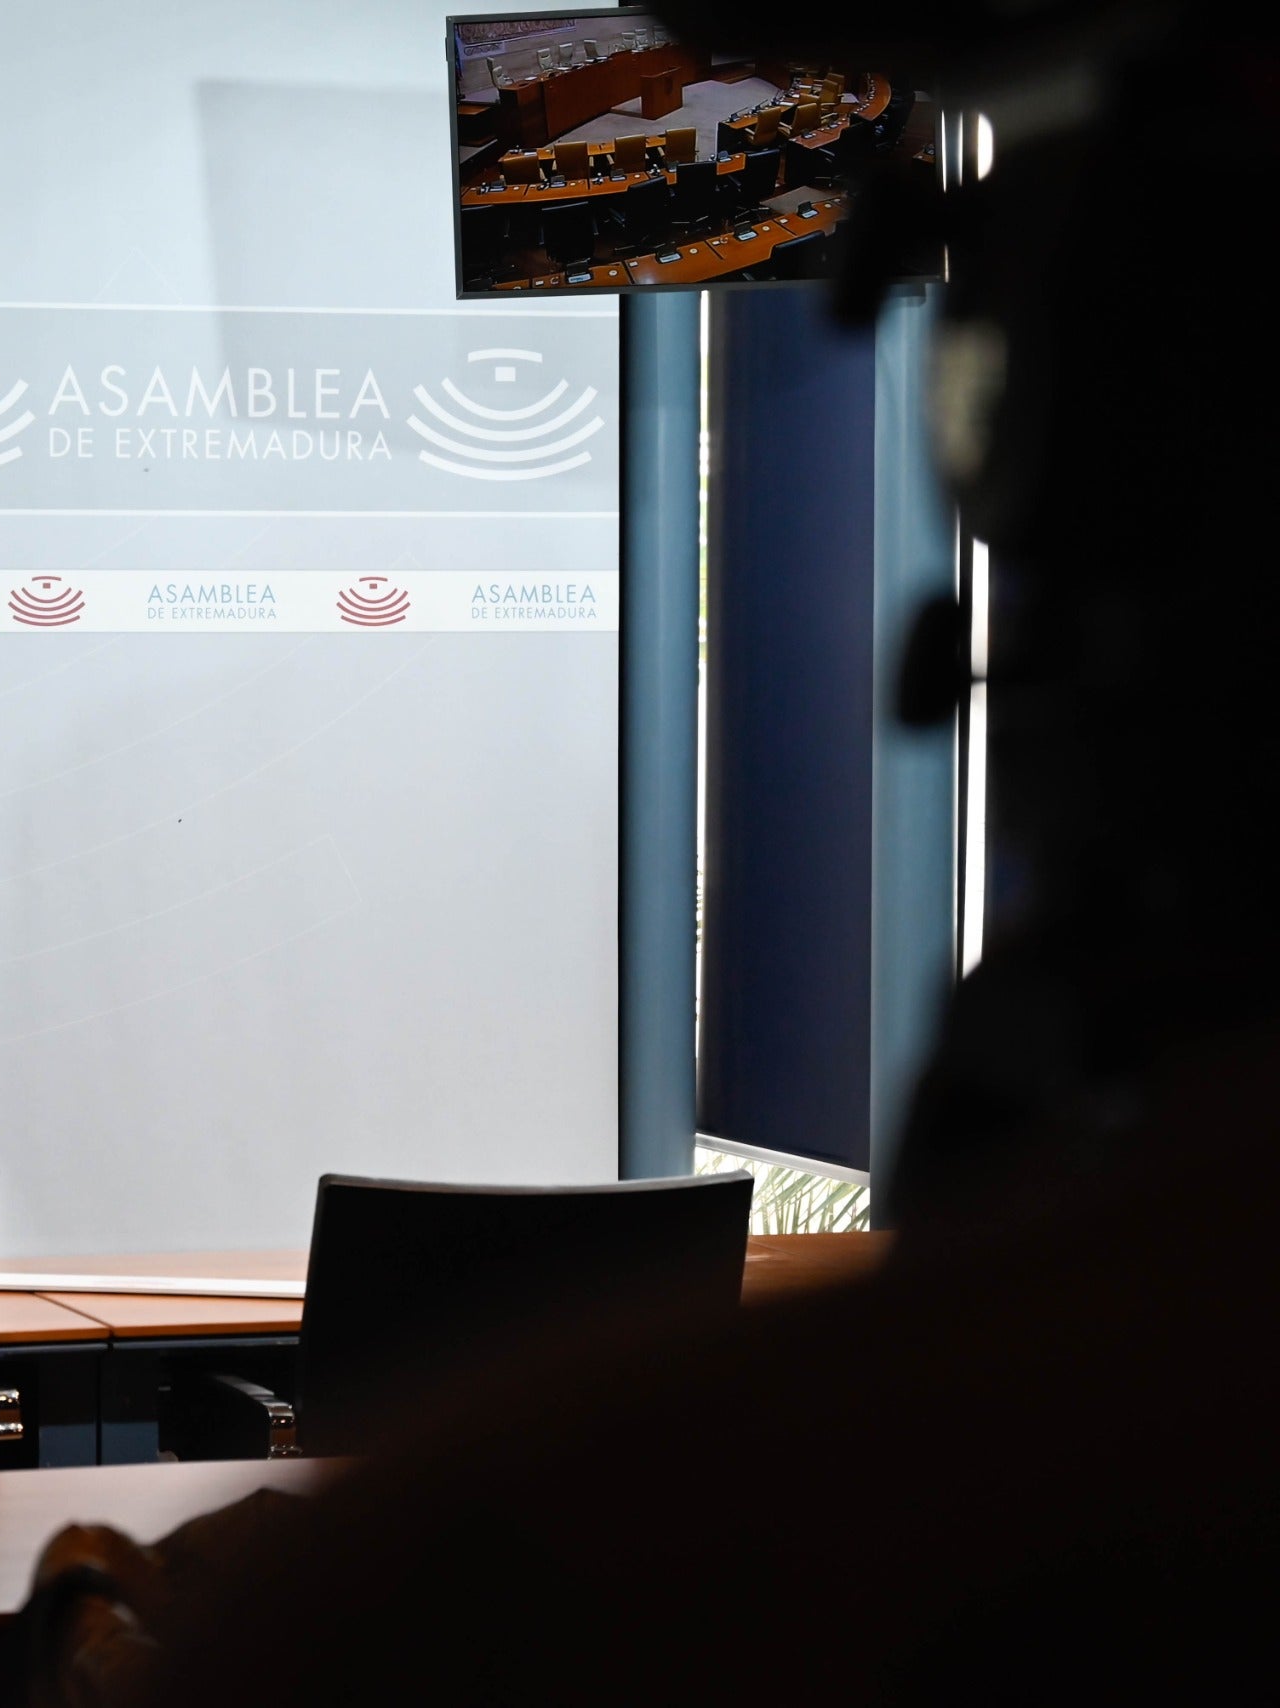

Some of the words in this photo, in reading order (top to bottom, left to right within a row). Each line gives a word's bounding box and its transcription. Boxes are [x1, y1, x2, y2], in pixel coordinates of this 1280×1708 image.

[48, 363, 391, 419] ASAMBLEA
[48, 427, 94, 458] DE
[115, 428, 393, 460] EXTREMADURA
[147, 583, 277, 604] ASAMBLEA
[471, 583, 597, 603] ASAMBLEA
[147, 607, 165, 620] DE
[171, 607, 277, 620] EXTREMADURA
[471, 606, 488, 619] DE
[495, 606, 597, 620] EXTREMADURA
